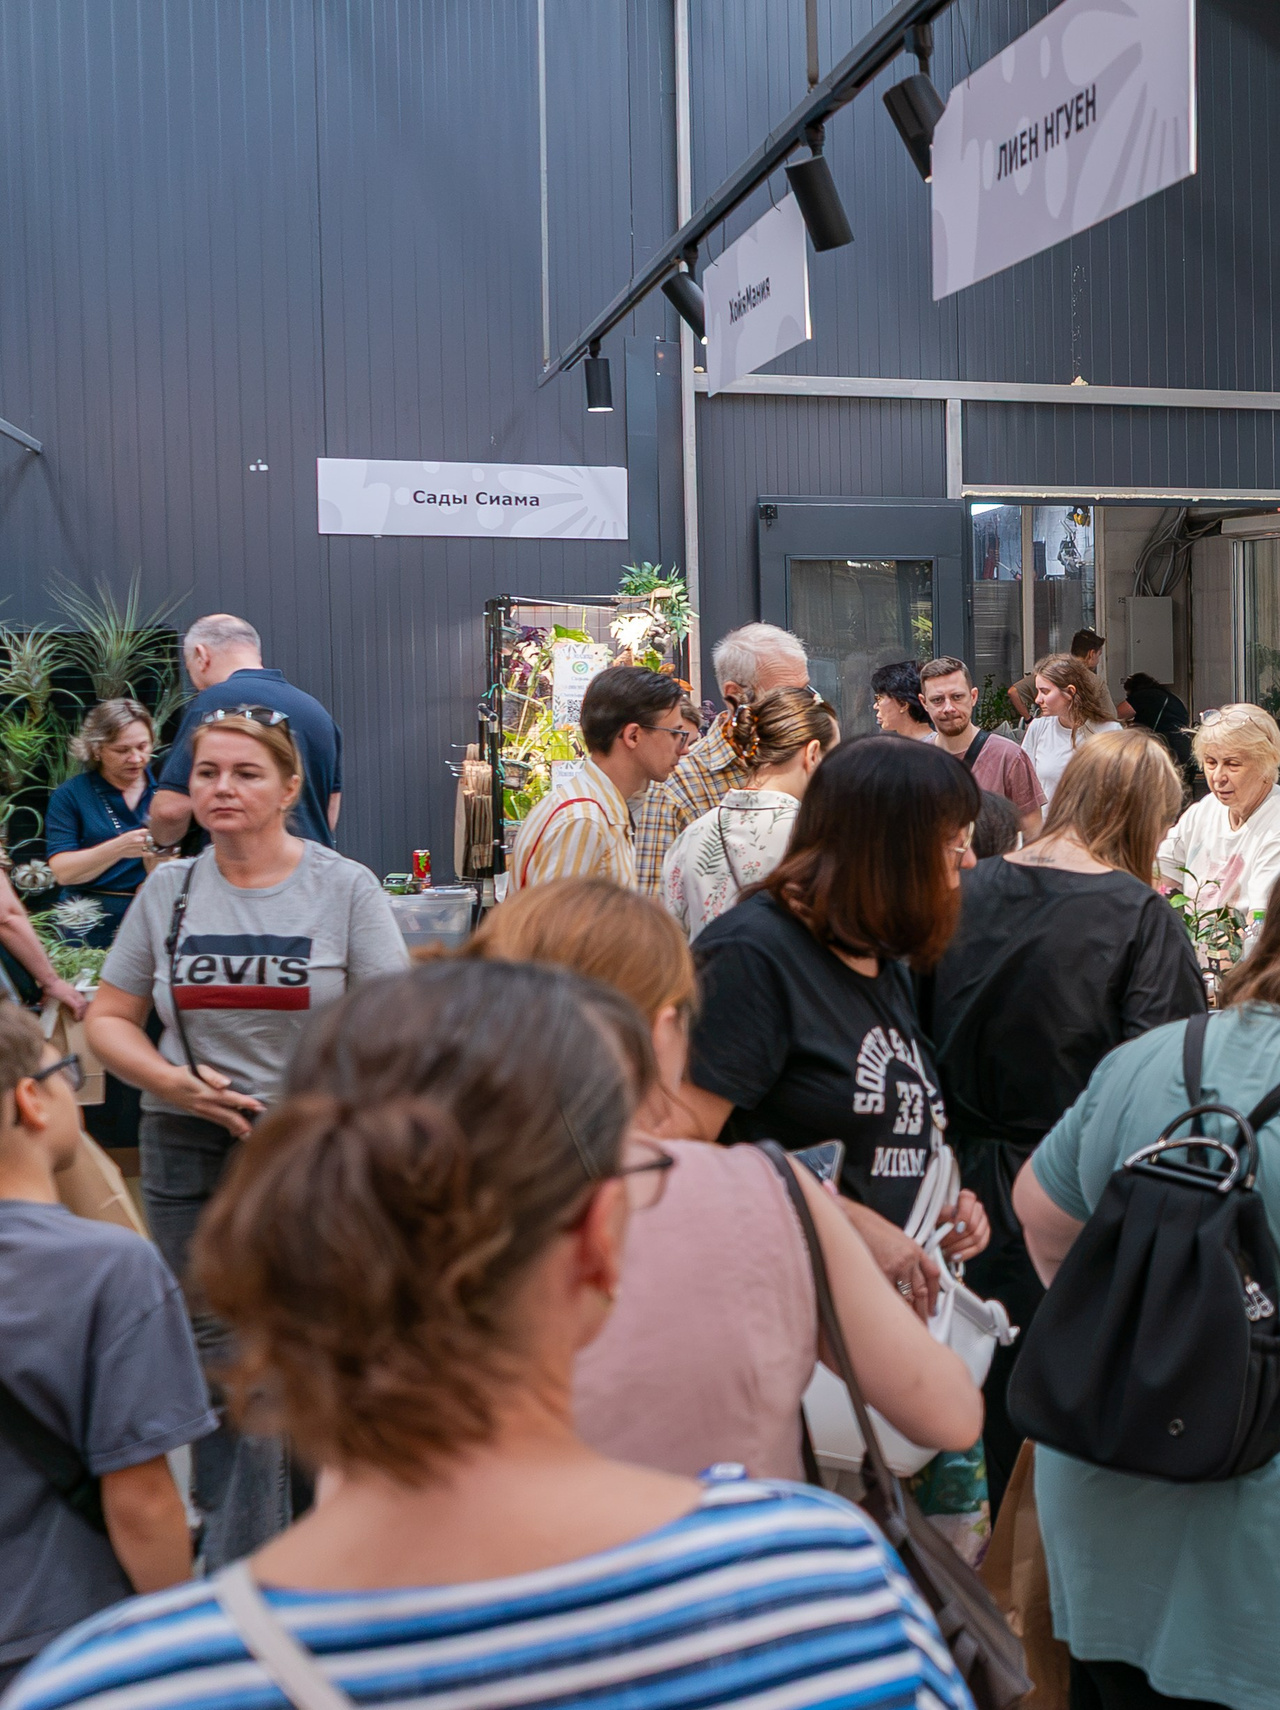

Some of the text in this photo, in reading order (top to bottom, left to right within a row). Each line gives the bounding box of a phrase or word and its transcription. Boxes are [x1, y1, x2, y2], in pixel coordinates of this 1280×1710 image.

[997, 83, 1097, 181] ЛИЕН НГУЕН
[413, 489, 540, 508] Сады Сиама
[892, 1081, 924, 1135] 33
[870, 1146, 930, 1177] MIAM
